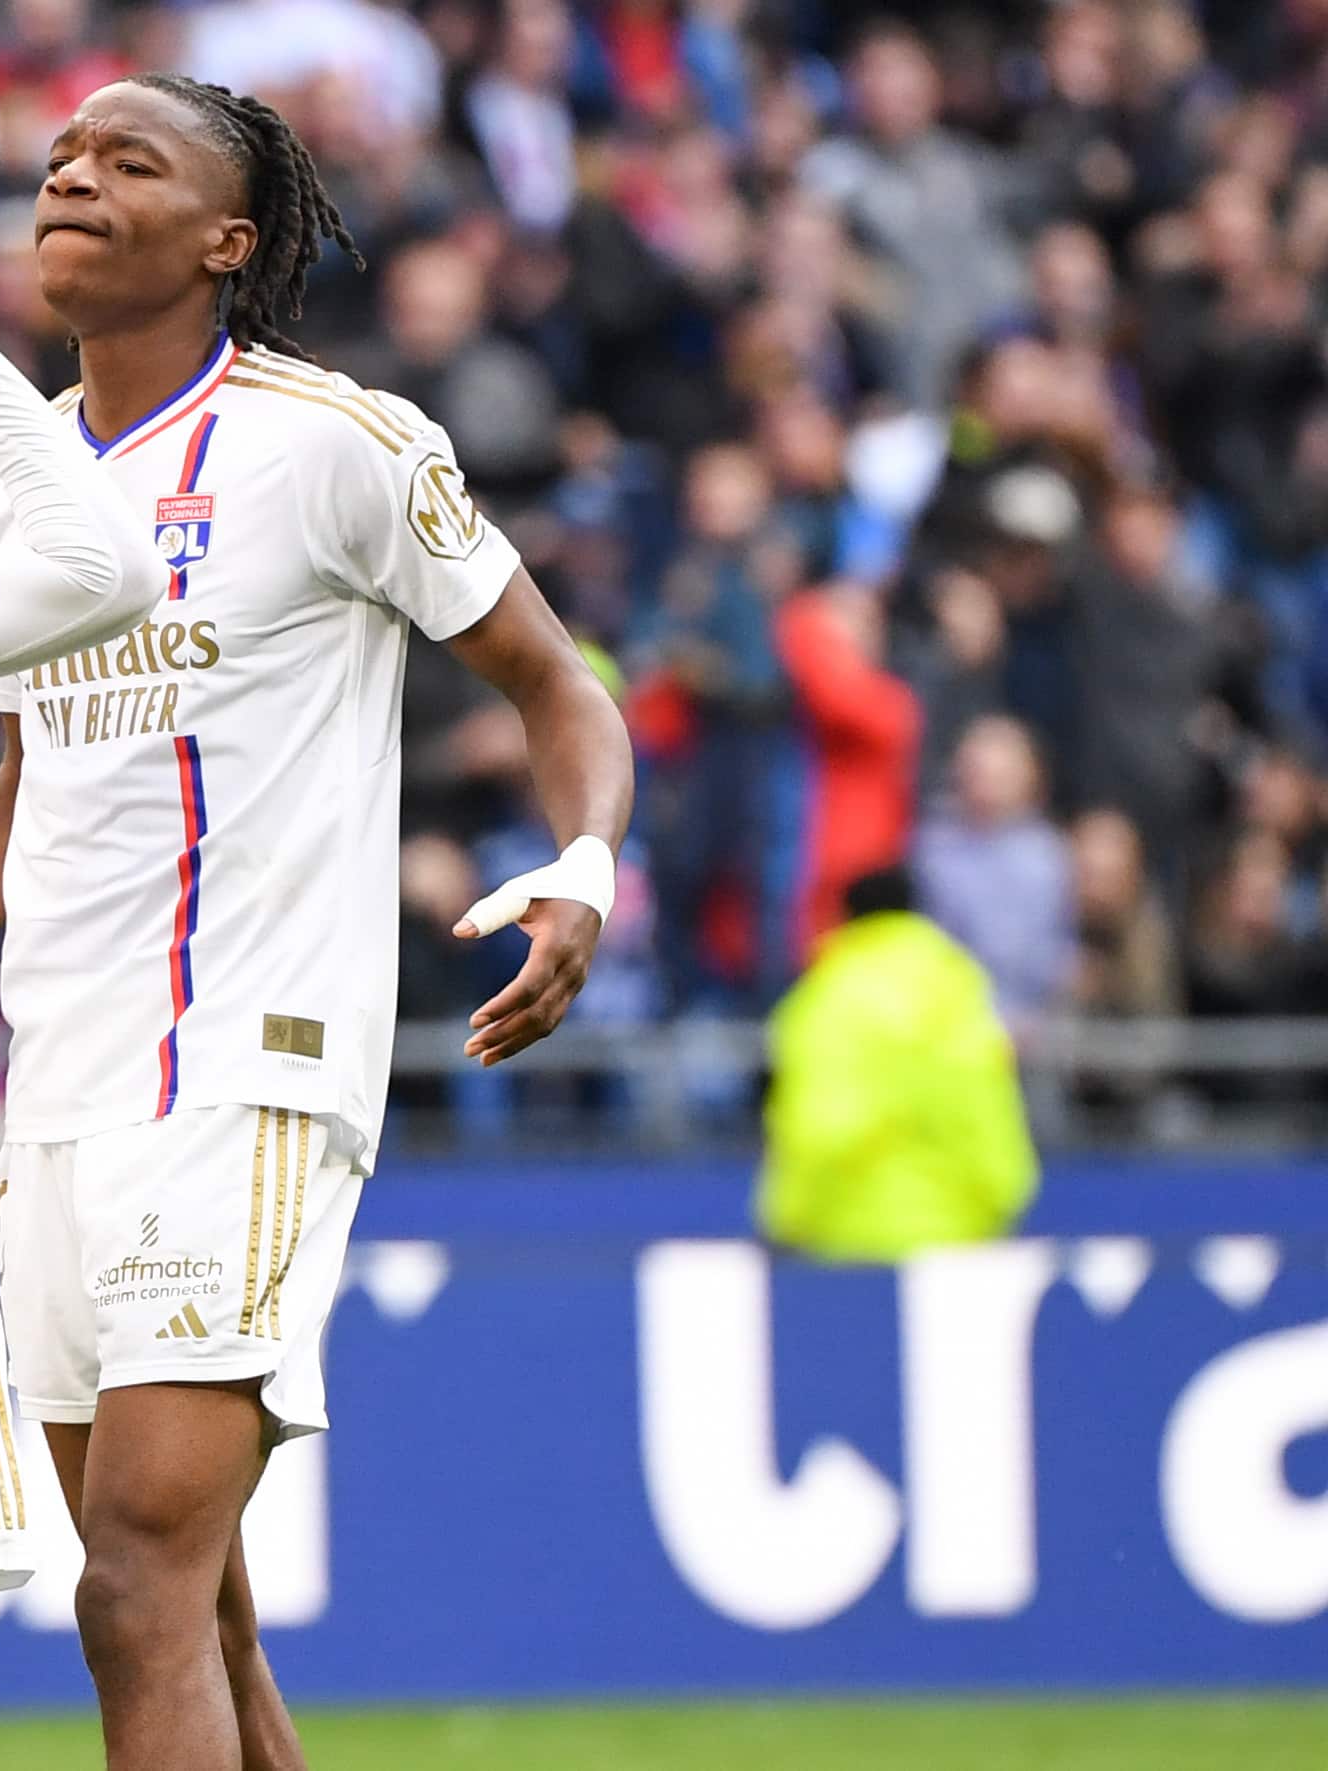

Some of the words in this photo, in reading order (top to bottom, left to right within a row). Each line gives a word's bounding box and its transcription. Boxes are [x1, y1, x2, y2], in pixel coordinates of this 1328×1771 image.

[158, 508, 210, 520] LYONNAIS
[26, 617, 221, 691] mirates
[84, 683, 179, 744] BETTER
[92, 1289, 135, 1308] ntérim
[140, 1280, 221, 1300] connecté
